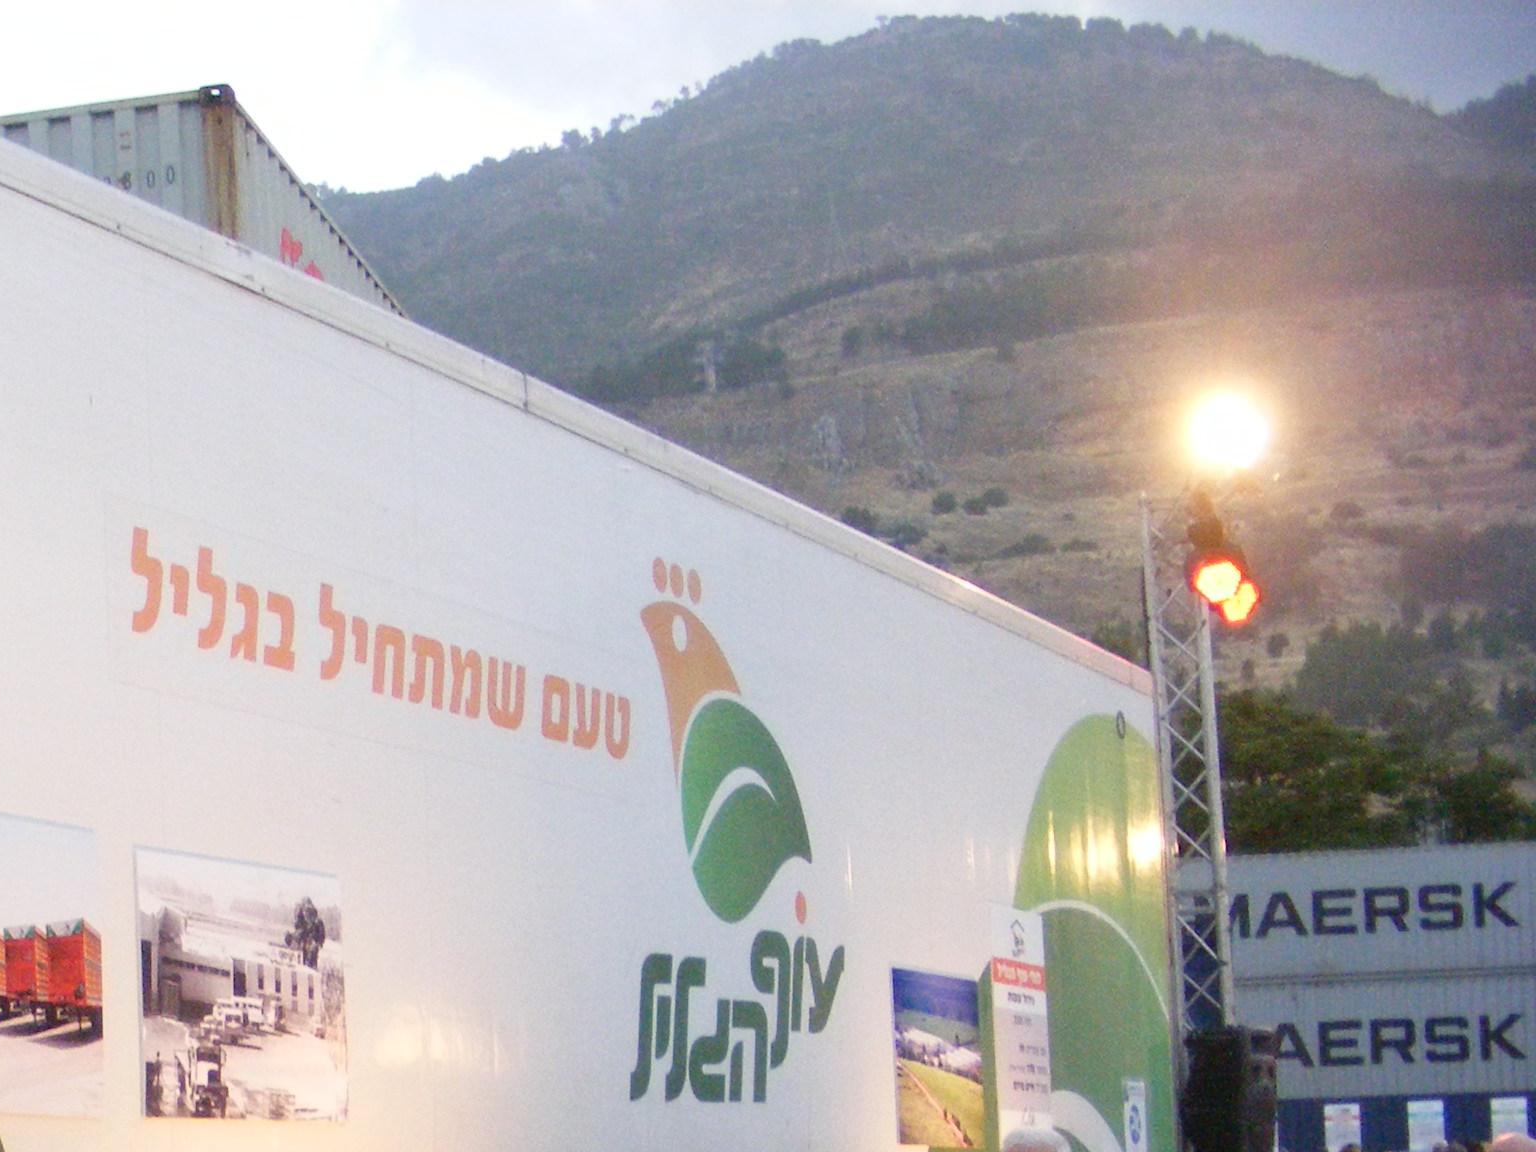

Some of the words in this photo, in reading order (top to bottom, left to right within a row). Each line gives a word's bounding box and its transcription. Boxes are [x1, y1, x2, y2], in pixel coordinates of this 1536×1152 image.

[131, 526, 296, 672] בגליל
[318, 582, 526, 731] שמתחיל
[541, 674, 631, 760] טעם
[749, 929, 844, 1070] עוף
[1275, 1012, 1527, 1068] AERSK
